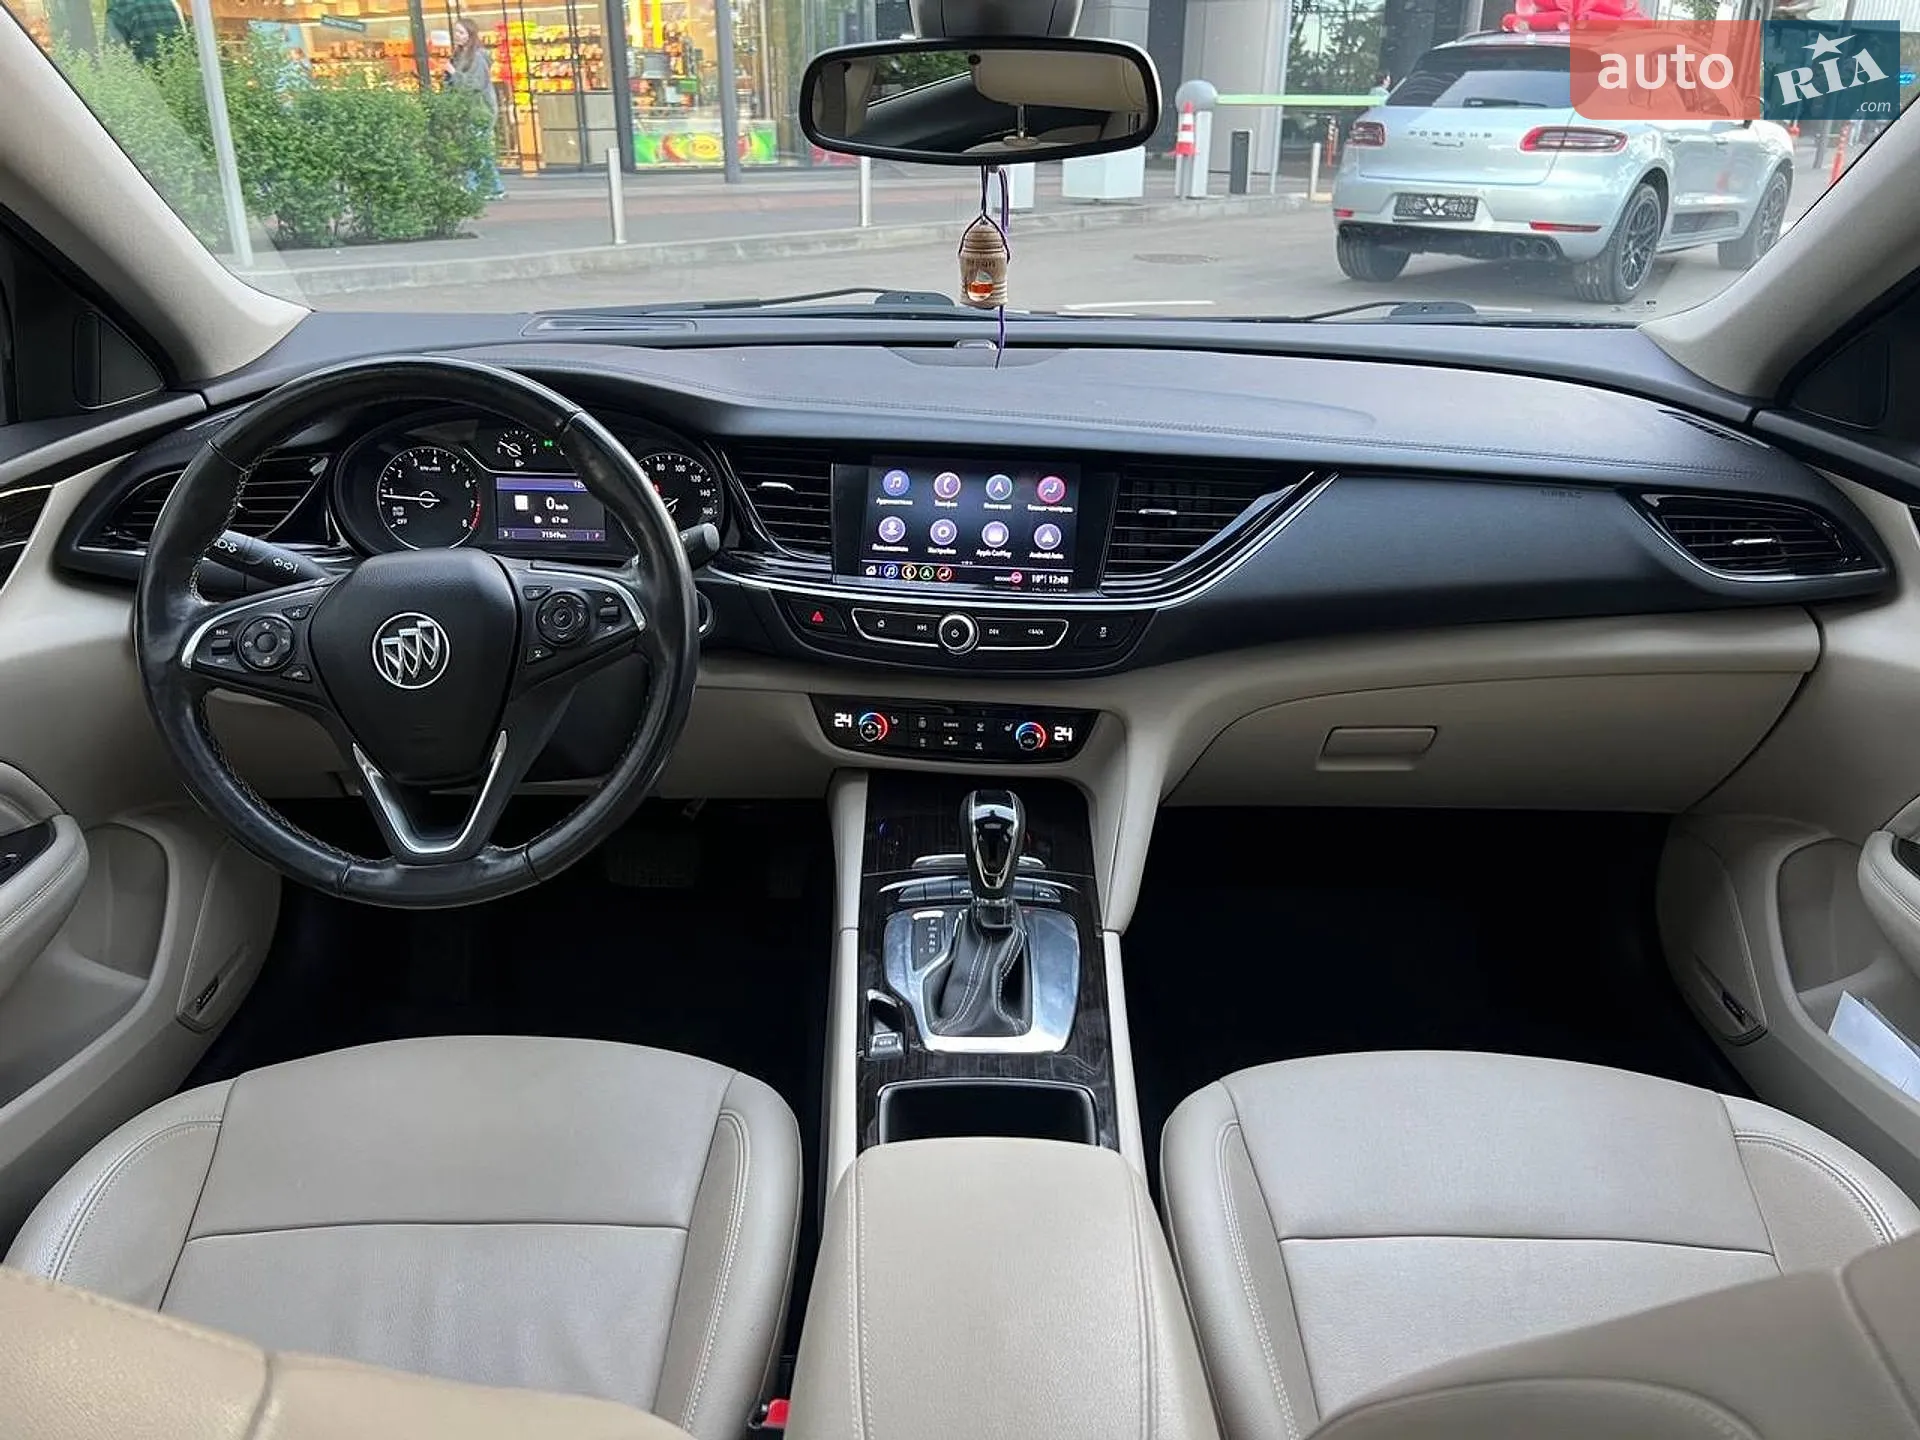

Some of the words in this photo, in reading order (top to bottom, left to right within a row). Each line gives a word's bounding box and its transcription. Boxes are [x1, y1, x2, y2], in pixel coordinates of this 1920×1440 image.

[656, 463, 666, 471] 80
[675, 464, 686, 472] 100
[546, 496, 555, 510] 0
[462, 519, 467, 528] 8
[834, 712, 853, 728] 24
[1054, 726, 1073, 742] 24
